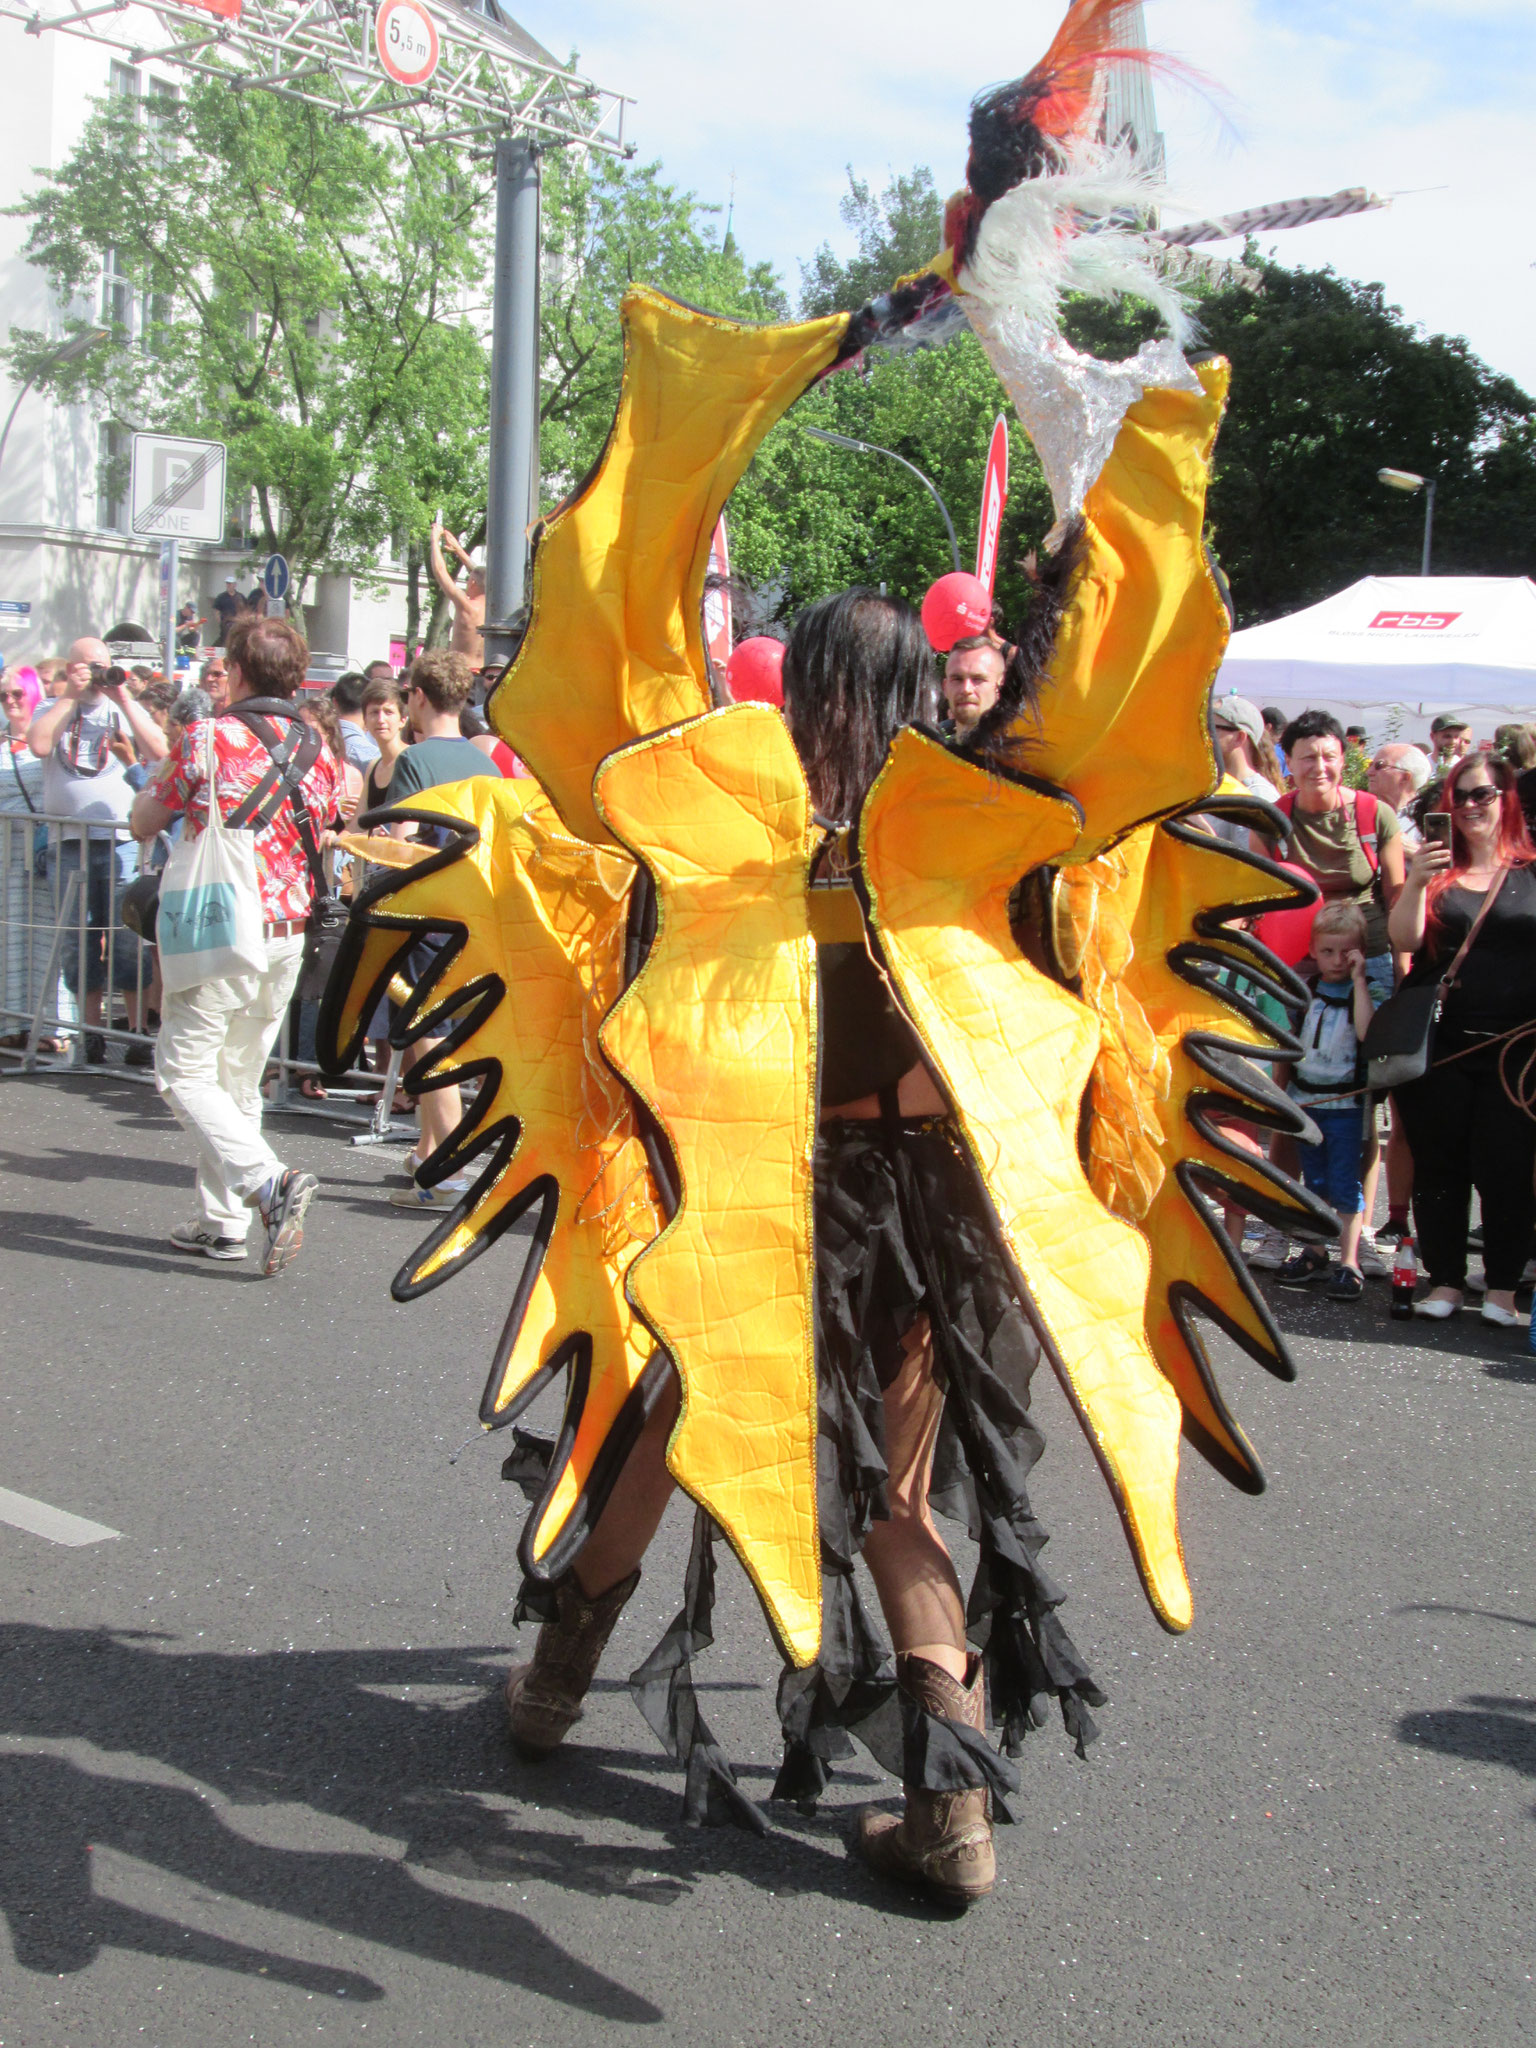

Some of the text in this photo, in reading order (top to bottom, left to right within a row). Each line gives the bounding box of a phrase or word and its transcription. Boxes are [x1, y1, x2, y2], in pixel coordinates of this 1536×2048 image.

[390, 17, 426, 57] 5,5 m
[1377, 614, 1446, 627] rbb
